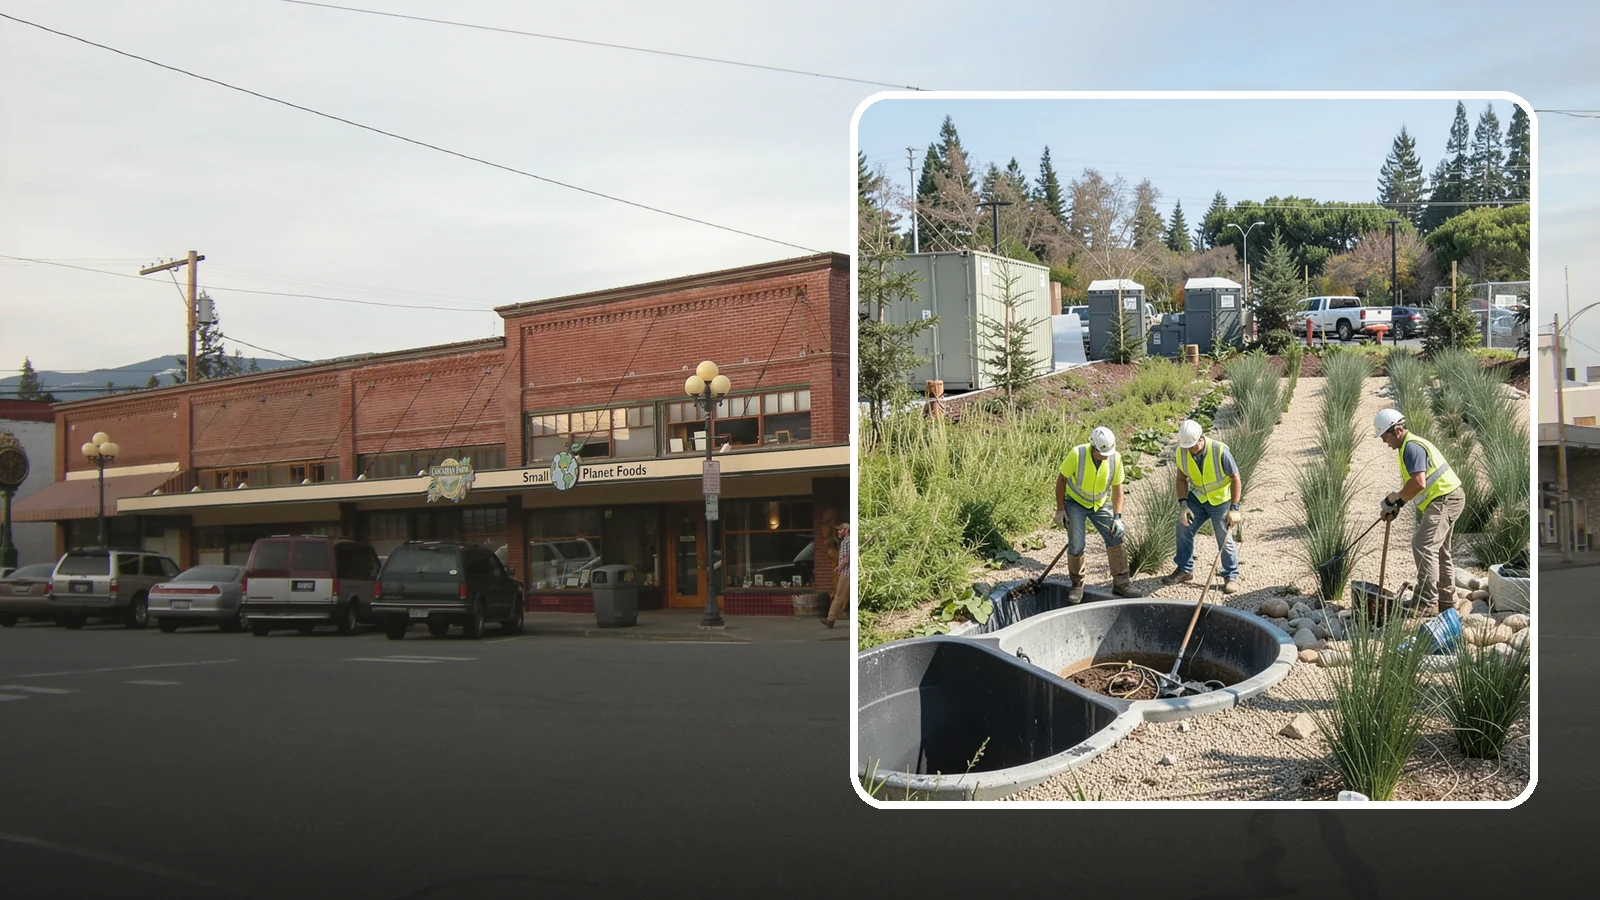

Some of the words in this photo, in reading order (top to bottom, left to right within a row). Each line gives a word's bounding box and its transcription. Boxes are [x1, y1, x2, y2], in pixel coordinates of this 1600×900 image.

[455, 465, 469, 475] FARM
[523, 471, 549, 483] Small
[582, 467, 614, 479] Planet
[617, 464, 647, 477] Foods
